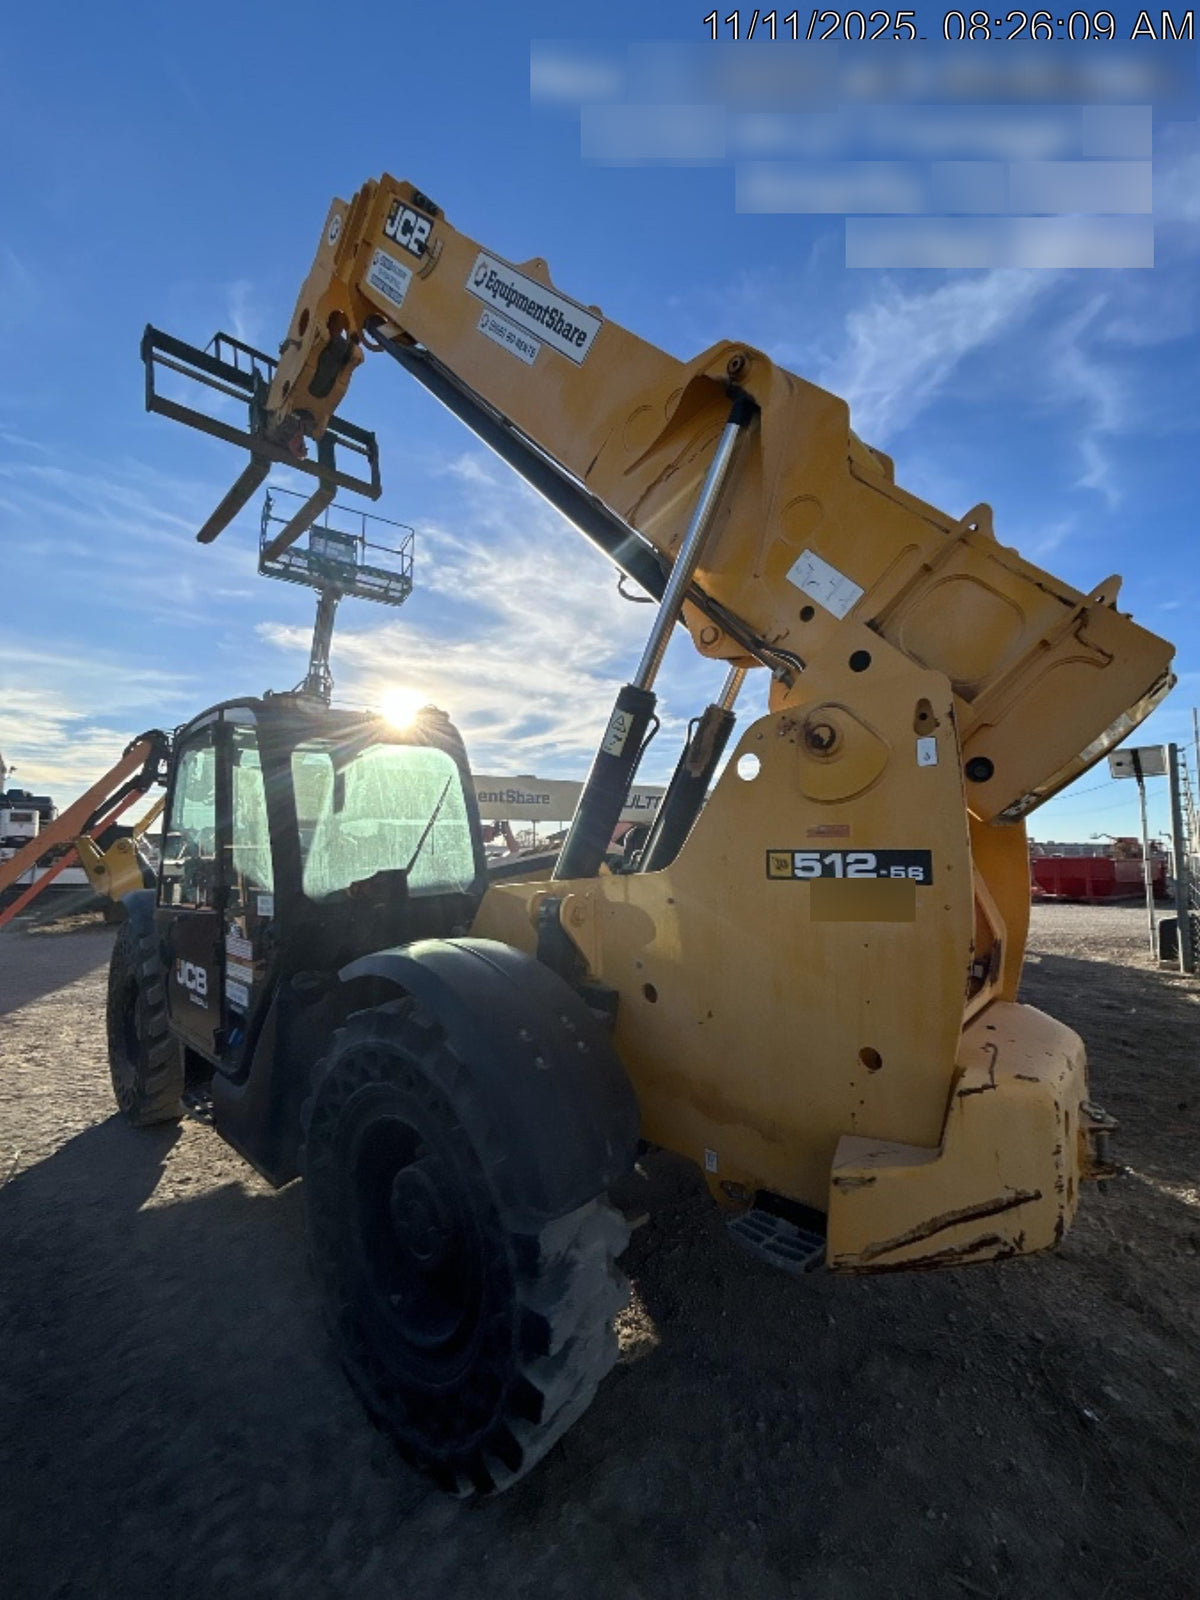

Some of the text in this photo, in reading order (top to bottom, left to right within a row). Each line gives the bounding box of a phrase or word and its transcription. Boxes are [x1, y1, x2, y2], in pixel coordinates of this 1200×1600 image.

[384, 205, 432, 255] JCB
[485, 270, 587, 347] EquipmentShare
[176, 958, 208, 996] JCB
